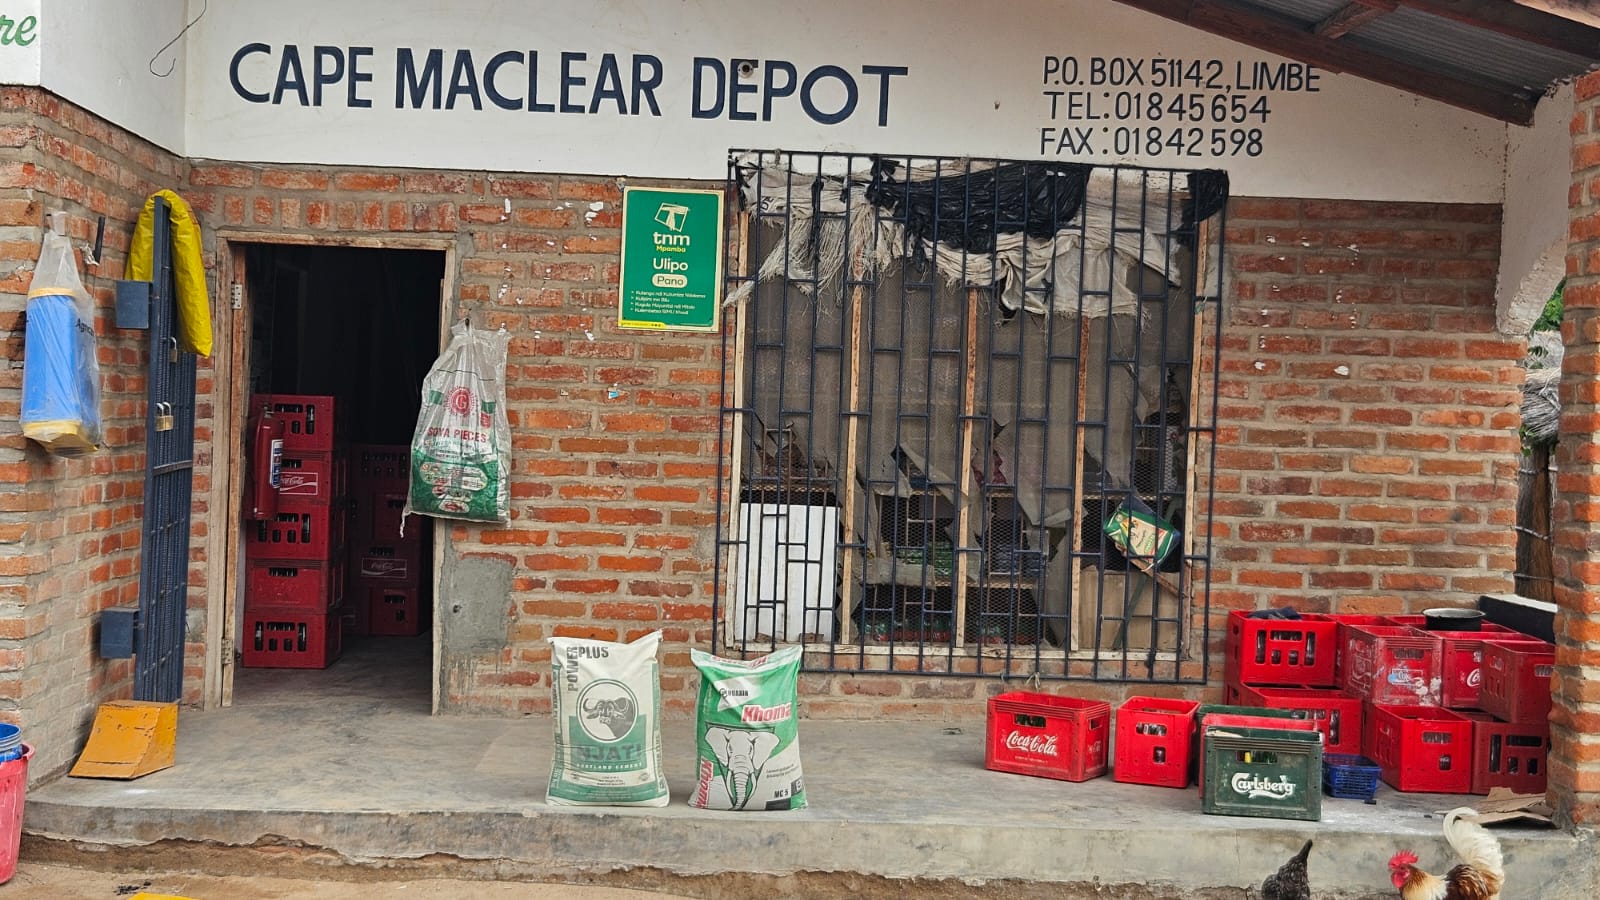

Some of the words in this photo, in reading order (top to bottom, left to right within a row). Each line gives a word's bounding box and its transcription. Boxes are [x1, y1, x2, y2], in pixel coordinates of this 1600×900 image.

[229, 42, 374, 108] CAPE
[395, 47, 662, 117] MACLEAR
[691, 56, 909, 127] DEPOT
[653, 231, 690, 246] tnm
[656, 245, 686, 253] Mpamba
[653, 257, 689, 273] Ulipo
[657, 275, 684, 286] Pano
[427, 427, 450, 438] SOYA
[454, 429, 487, 443] PIECES
[578, 646, 609, 659] PLUS
[566, 646, 579, 692] POWER
[1006, 730, 1058, 757] Coca-Cola
[1231, 772, 1297, 799] Carlsberg
